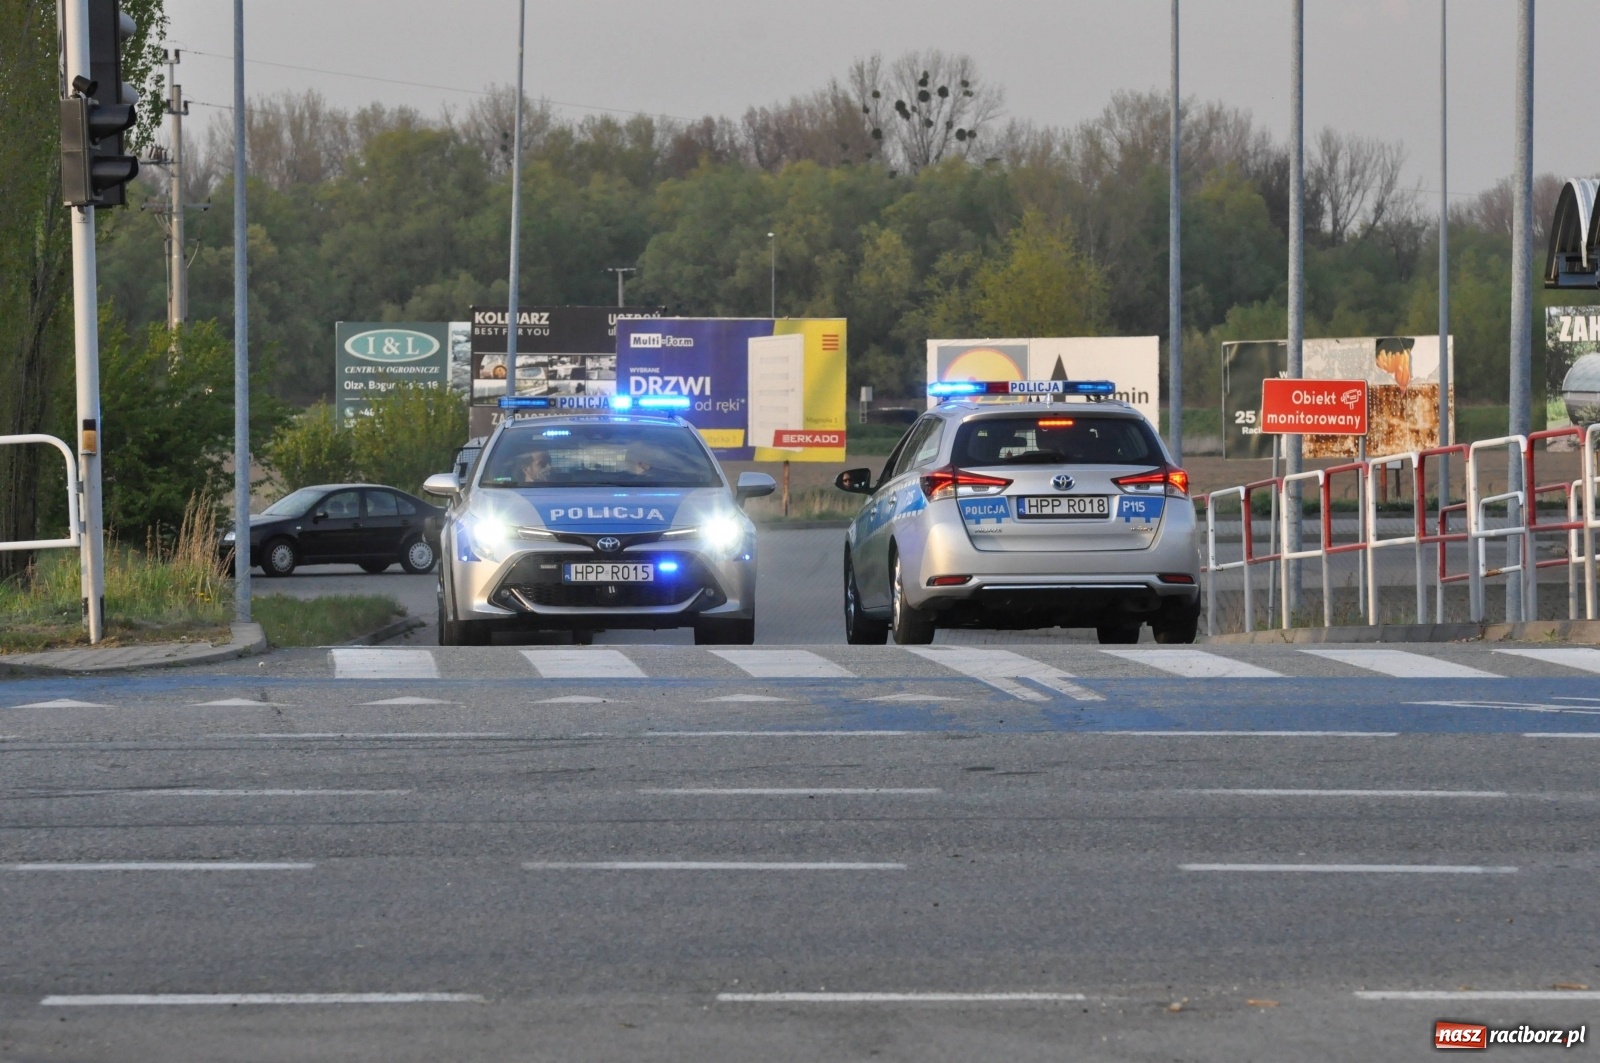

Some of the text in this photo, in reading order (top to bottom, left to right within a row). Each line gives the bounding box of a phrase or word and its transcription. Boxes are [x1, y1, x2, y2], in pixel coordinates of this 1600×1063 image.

[474, 327, 550, 336] BEST FR YOU
[367, 336, 420, 355] I & L
[386, 366, 440, 374] OGRODNICZE
[629, 376, 711, 396] DRZWI
[1010, 382, 1060, 392] POLICJA
[559, 397, 609, 409] POLICJA
[1291, 390, 1337, 405] Obiekt
[694, 399, 712, 411] od
[1234, 411, 1256, 424] 25
[1266, 411, 1362, 429] monitorowany
[790, 434, 839, 443] ERKADO
[965, 504, 1006, 516] POLICJA
[1028, 499, 1106, 513] HPP R018
[1122, 501, 1146, 513] P115
[550, 507, 665, 521] POLICJA
[574, 565, 650, 580] HPP R015
